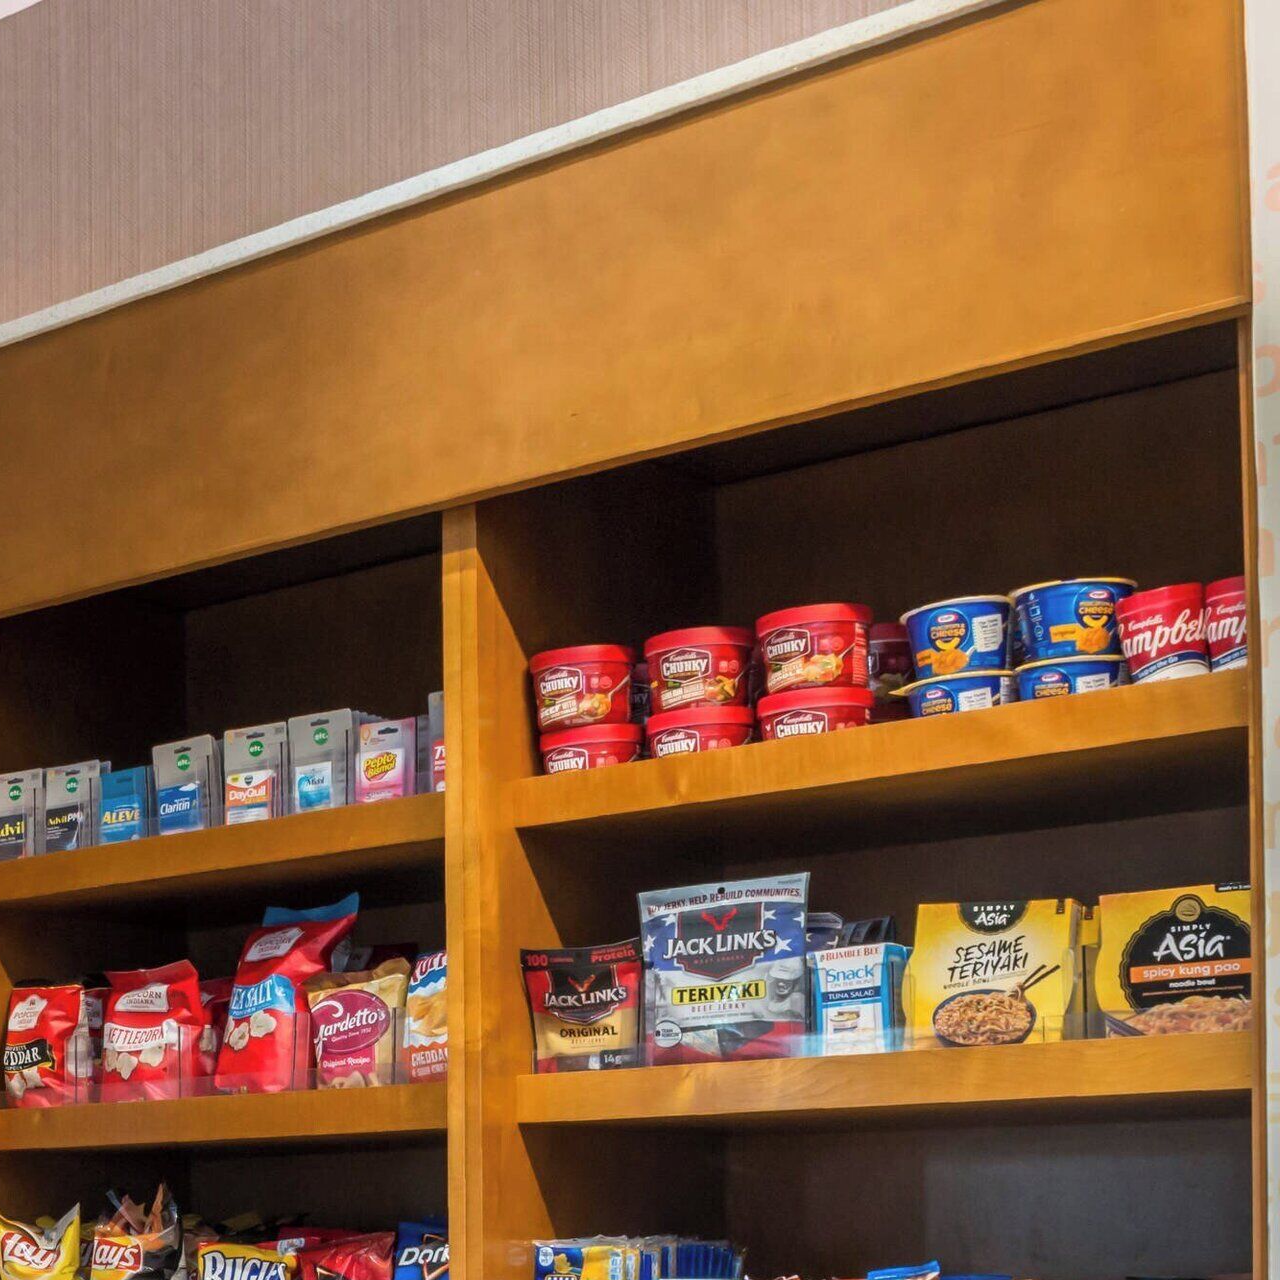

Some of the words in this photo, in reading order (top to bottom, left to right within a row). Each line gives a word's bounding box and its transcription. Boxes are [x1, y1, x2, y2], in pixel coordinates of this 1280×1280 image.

[766, 638, 808, 658] CHUNKY
[662, 658, 709, 677] CHUNKY
[540, 676, 579, 693] CHUNKY
[776, 720, 825, 740] CHUNKY
[656, 739, 696, 757] CHUNKY
[367, 763, 396, 779] Bismol
[548, 757, 587, 774] CHUNKY
[229, 787, 267, 801] DayQuil
[160, 801, 190, 816] Claritin
[662, 897, 689, 912] JERKY.
[689, 893, 708, 906] HELP
[709, 889, 743, 905] REBUILD
[744, 886, 803, 900] COMMUNITIES.
[973, 903, 1016, 913] SIMPLY
[975, 911, 1010, 927] Asia
[1170, 923, 1212, 933] SIMPLY
[664, 936, 716, 959] JACK
[715, 929, 778, 955] LINK'S
[862, 946, 881, 957] BEE
[953, 935, 1026, 965] SESAME
[1154, 933, 1229, 962] Asia
[525, 954, 549, 967] 100
[590, 947, 636, 963] Protein
[825, 964, 874, 984] Snack
[947, 952, 1028, 984] TERIYAKI
[1142, 966, 1176, 980] spicy
[1178, 963, 1213, 978] kung
[1213, 961, 1241, 975] pao
[676, 980, 762, 1003] TERIYAKI
[1168, 979, 1197, 990] noodle
[1197, 978, 1217, 988] bowl
[543, 991, 585, 1007] JACK
[586, 986, 627, 1005] LINK'S
[827, 991, 849, 1001] TUNA
[850, 988, 876, 999] SALAD
[691, 1003, 716, 1013] BEEF
[717, 1001, 746, 1012] JERKY
[559, 1025, 619, 1039] ORIGINAL
[322, 1059, 347, 1068] Original
[347, 1056, 371, 1066] Recipe
[602, 1053, 623, 1066] 14g
